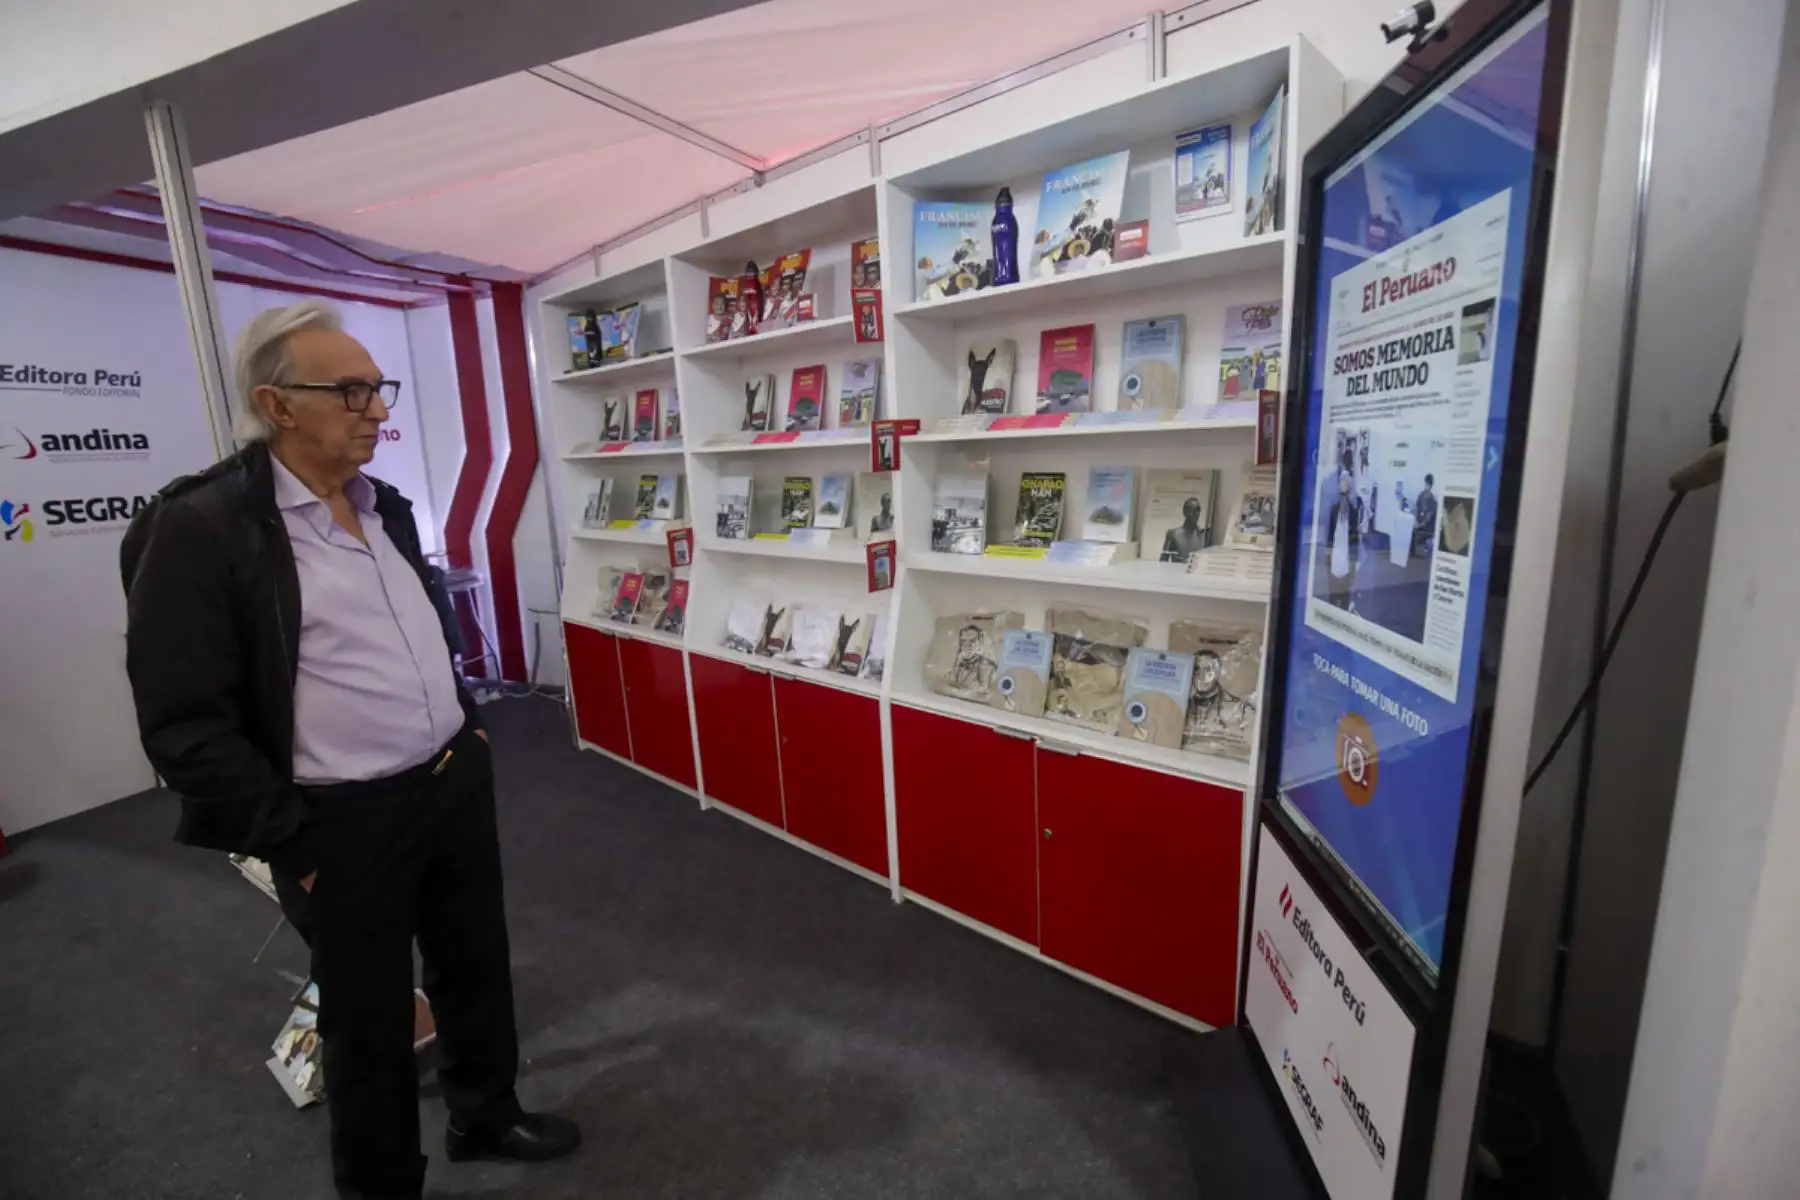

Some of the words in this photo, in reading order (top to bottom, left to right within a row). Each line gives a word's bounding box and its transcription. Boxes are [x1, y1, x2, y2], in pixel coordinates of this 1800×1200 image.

[1361, 280, 1377, 313] El
[1379, 256, 1456, 306] Peruano
[0, 364, 87, 385] Editora
[94, 370, 141, 388] Perú
[1333, 347, 1375, 376] SOMOS
[1377, 325, 1455, 366] MEMORIA
[62, 386, 97, 397] FONDO
[98, 387, 141, 399] EDITORIAL
[1346, 374, 1370, 397] DEL
[1372, 361, 1429, 393] MUNDO
[41, 429, 149, 452] andina
[42, 495, 158, 525] SEGRA
[1312, 652, 1330, 675] TOCA
[1330, 664, 1349, 687] PARA
[1350, 675, 1379, 706] TOMAR
[1379, 694, 1399, 719] UNA
[1401, 706, 1428, 736] FOTO
[1257, 930, 1265, 956] El
[1265, 946, 1298, 1015] Peruano
[1292, 906, 1333, 978] Editora
[1334, 967, 1366, 1027] Perú
[1291, 1064, 1324, 1131] SEGRAF
[1342, 1075, 1386, 1160] andina
